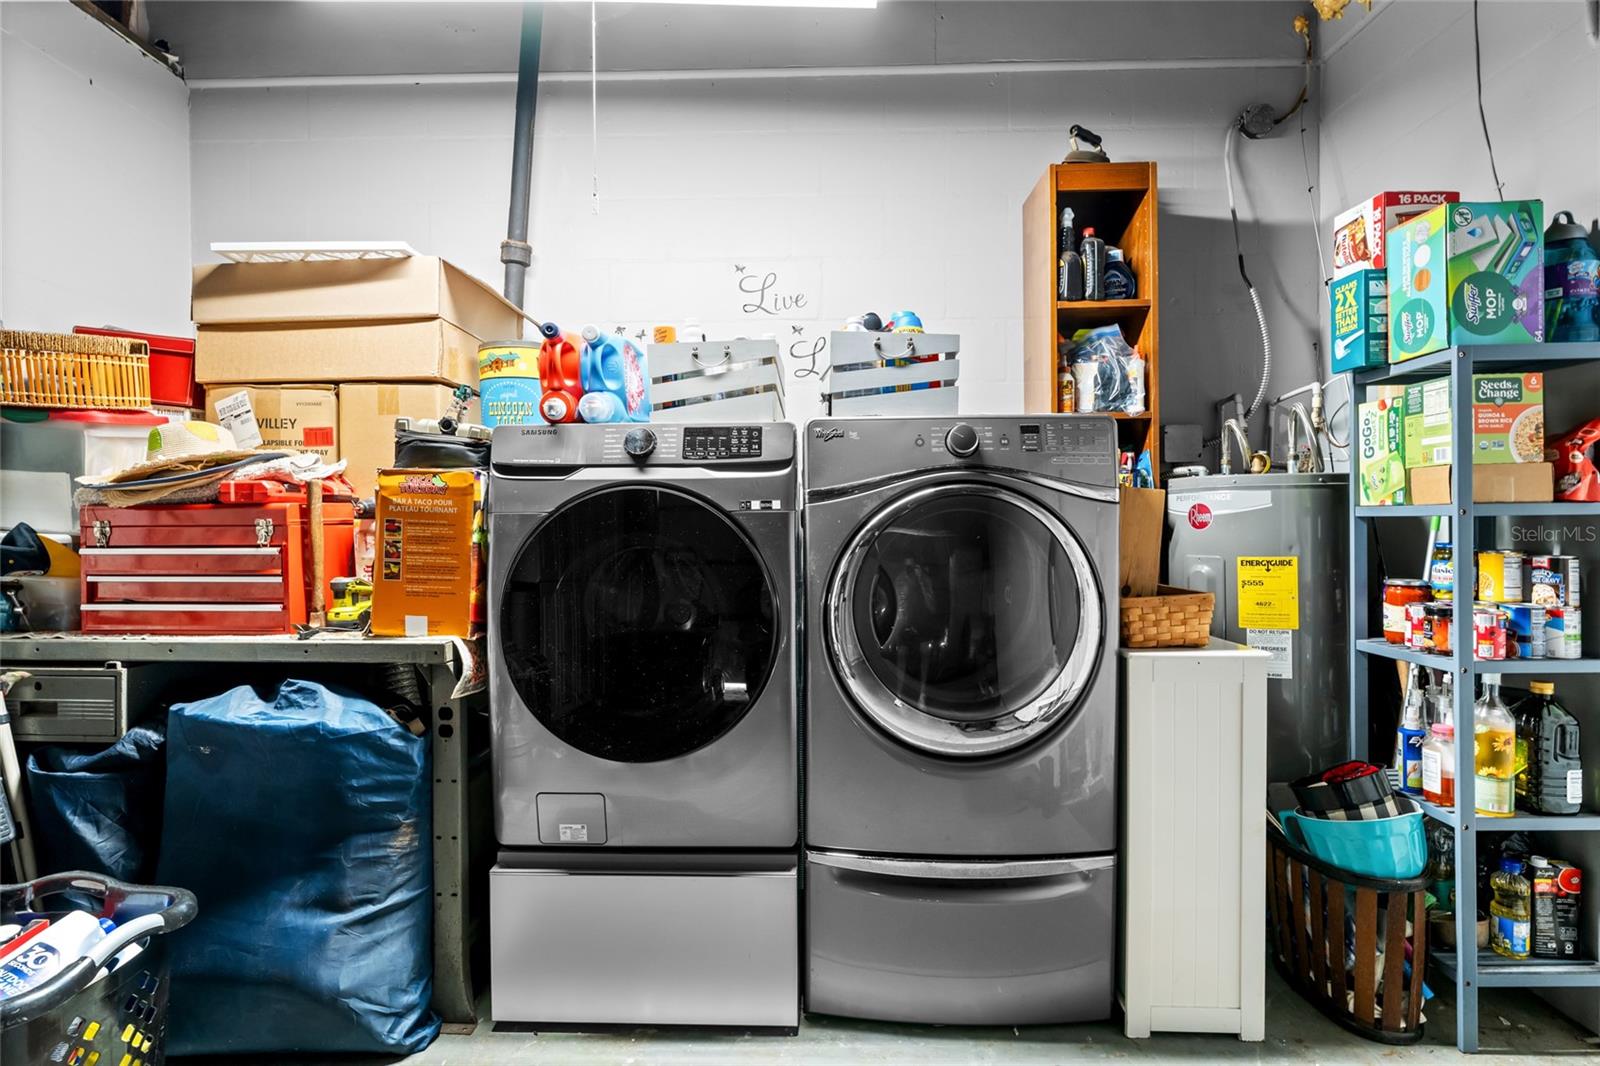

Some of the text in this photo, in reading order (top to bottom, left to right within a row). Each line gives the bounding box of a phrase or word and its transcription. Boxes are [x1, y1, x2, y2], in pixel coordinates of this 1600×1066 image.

[1399, 194, 1446, 204] 16 PACK
[738, 272, 808, 315] Live
[1335, 287, 1357, 311] 2X
[1464, 283, 1481, 325] Swiffer
[1486, 288, 1497, 319] MOP
[1416, 312, 1425, 338] MOP
[1535, 330, 1543, 342] 64
[1480, 380, 1512, 391] Seeds
[1530, 376, 1537, 385] 6
[1478, 388, 1519, 399] Change
[488, 401, 534, 417] LINCOLN
[521, 428, 558, 436] SAMSUNG
[1362, 418, 1375, 459] GoGo
[389, 505, 458, 514] PLATEAU TOURNANT
[16, 945, 51, 970] 30
